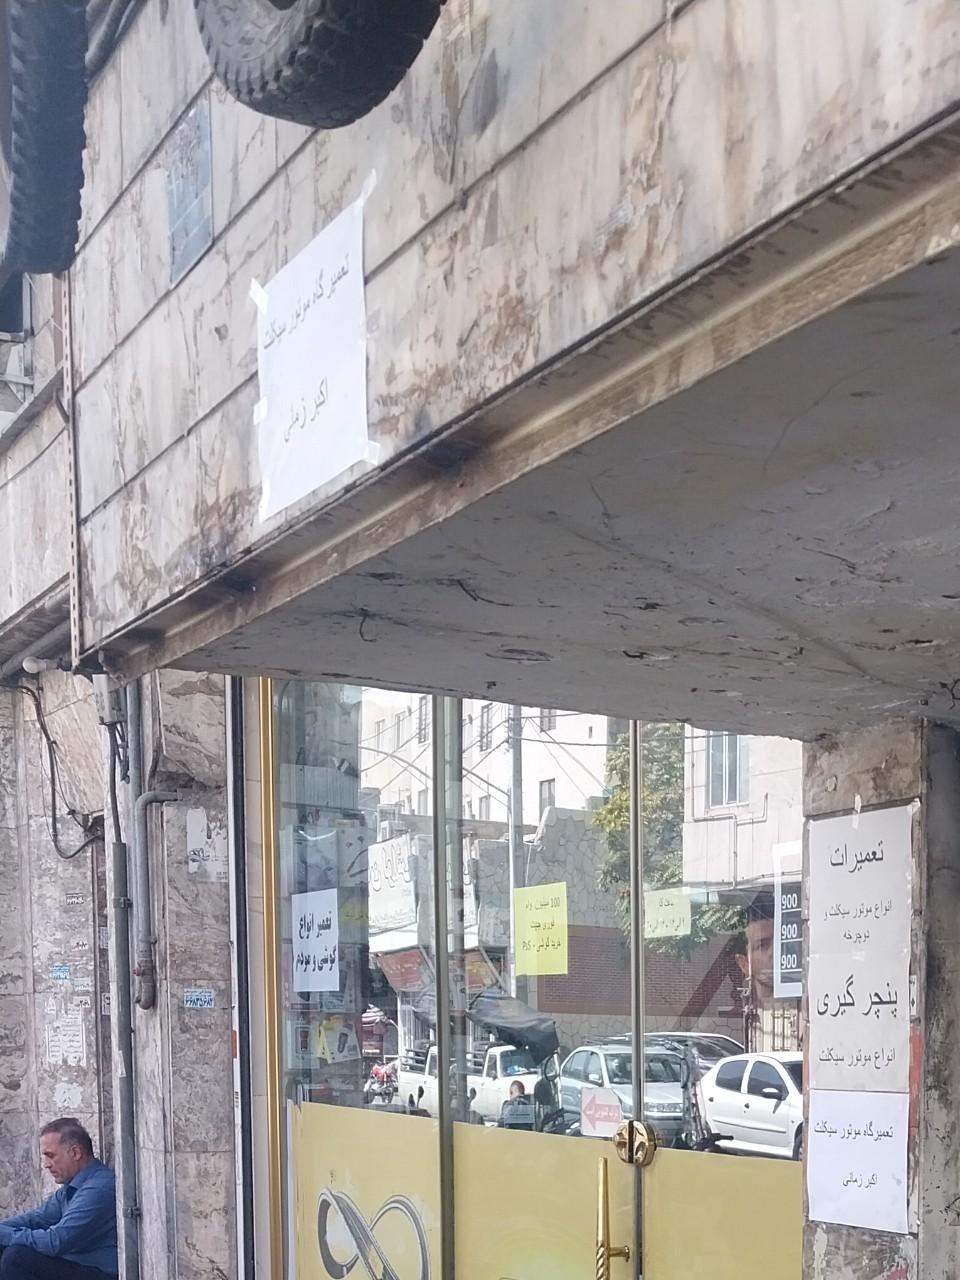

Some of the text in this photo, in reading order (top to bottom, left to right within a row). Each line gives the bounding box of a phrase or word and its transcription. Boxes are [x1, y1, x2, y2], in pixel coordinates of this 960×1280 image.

[829, 839, 885, 873] تعمیرات
[781, 893, 798, 909] 900
[874, 897, 893, 920] انواع
[829, 902, 850, 920] سیکلت
[852, 902, 873, 919] موتور
[298, 911, 315, 939] انواع
[781, 923, 798, 939] 900
[317, 944, 337, 973] گوشی
[781, 954, 797, 969] 900
[816, 973, 898, 1019] پنچر گیری
[819, 1047, 896, 1069] انواع موتور سیکلت
[814, 1119, 838, 1138] سیکلت
[840, 1122, 862, 1140] موتور
[842, 1172, 879, 1189] اکبر زمانی
